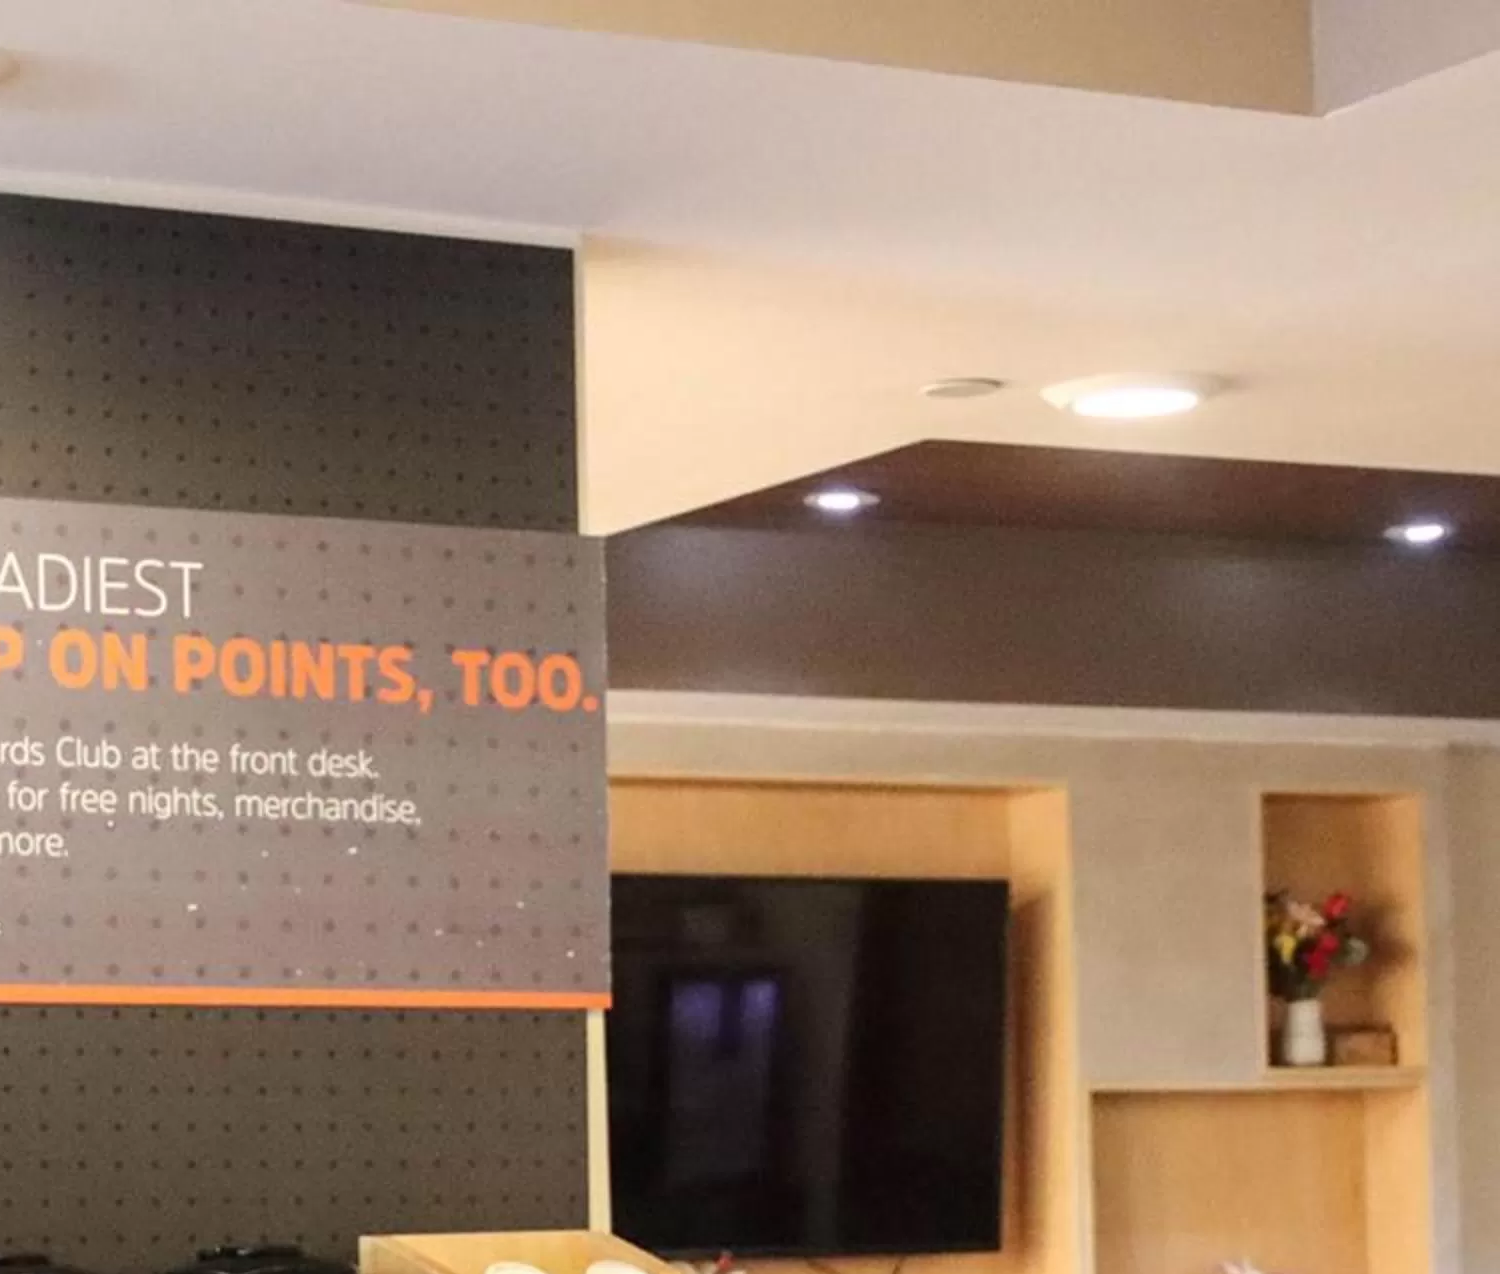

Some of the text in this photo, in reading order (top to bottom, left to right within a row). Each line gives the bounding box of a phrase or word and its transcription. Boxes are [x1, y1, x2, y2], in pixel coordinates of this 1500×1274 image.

[48, 628, 148, 691] ON
[172, 633, 434, 714] POINTS,
[451, 648, 599, 713] TOO.
[55, 736, 122, 769] Club
[131, 745, 161, 771] at
[170, 742, 220, 774] the
[229, 743, 299, 776] front
[307, 749, 380, 779] desk.
[7, 780, 49, 812] for
[60, 781, 117, 814] free
[128, 786, 224, 821] nights,
